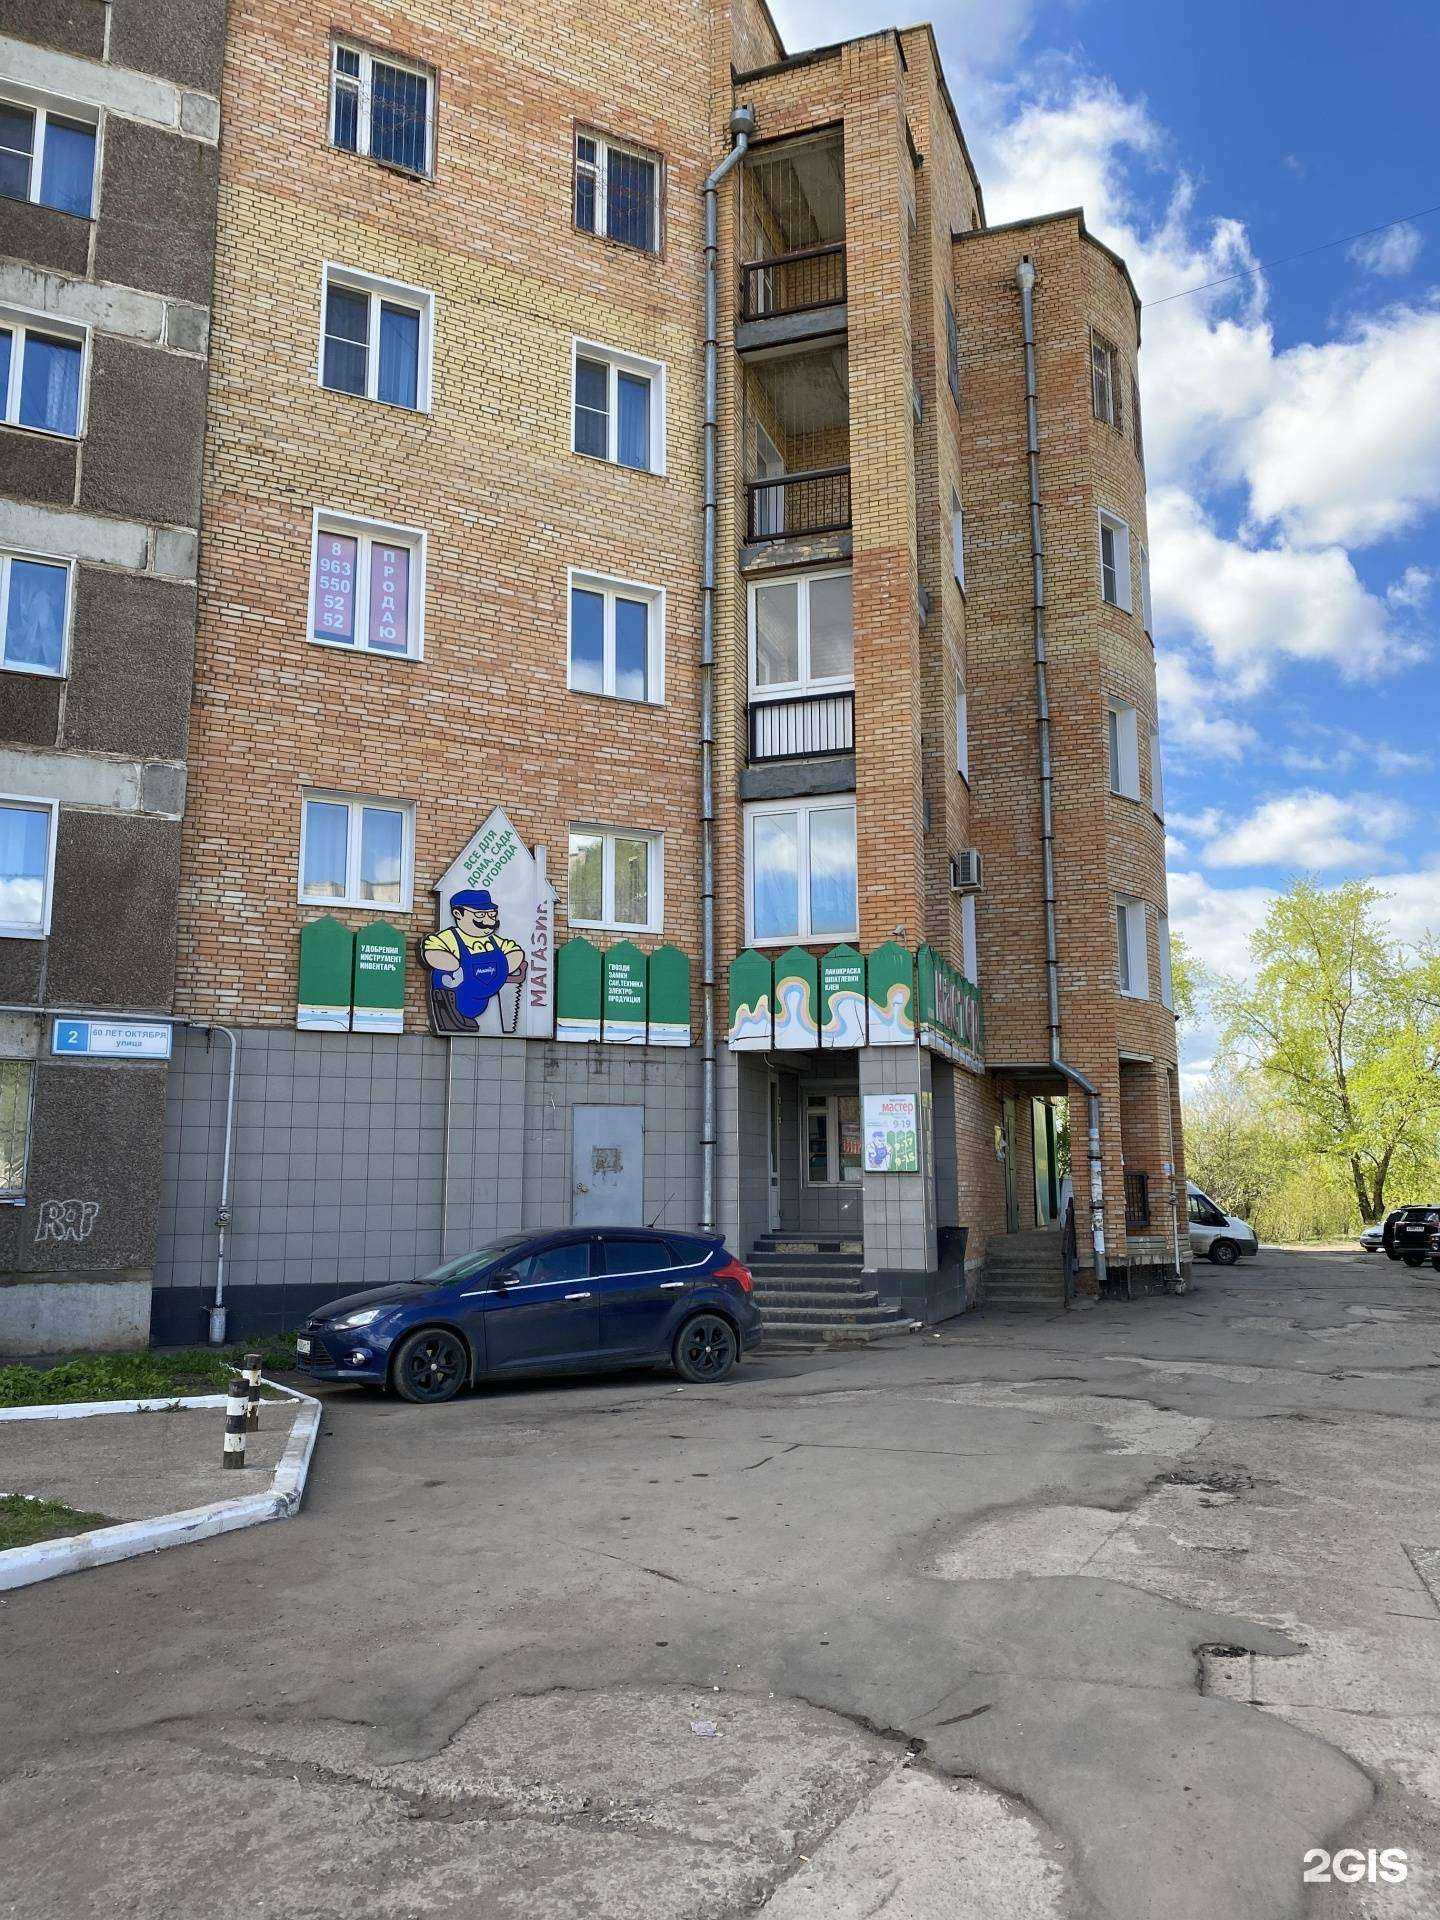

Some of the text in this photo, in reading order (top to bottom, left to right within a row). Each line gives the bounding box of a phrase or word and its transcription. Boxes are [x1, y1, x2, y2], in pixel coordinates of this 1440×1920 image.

[331, 542, 341, 556] 8
[320, 558, 351, 576] 963
[320, 576, 350, 593] 550
[379, 550, 396, 638] ПРОДАЮ
[324, 595, 344, 611] 52
[323, 612, 343, 628] 52
[463, 829, 497, 871] ВСЕ ДЛЯ
[467, 830, 514, 888] ДОМА, САДА
[482, 844, 518, 887] ОГОРОДА
[361, 944, 399, 954] УДОБРЕНИЯ
[360, 953, 402, 963] ИНСТРУМЕНТ
[360, 962, 396, 971] ИНВЕНТАРЬ
[67, 1030, 79, 1044] 2
[105, 1029, 122, 1038] ЛЕТ
[124, 1030, 167, 1039] ОКТЯБРЯ
[115, 1039, 143, 1048] улица
[882, 1103, 914, 1115] мастер
